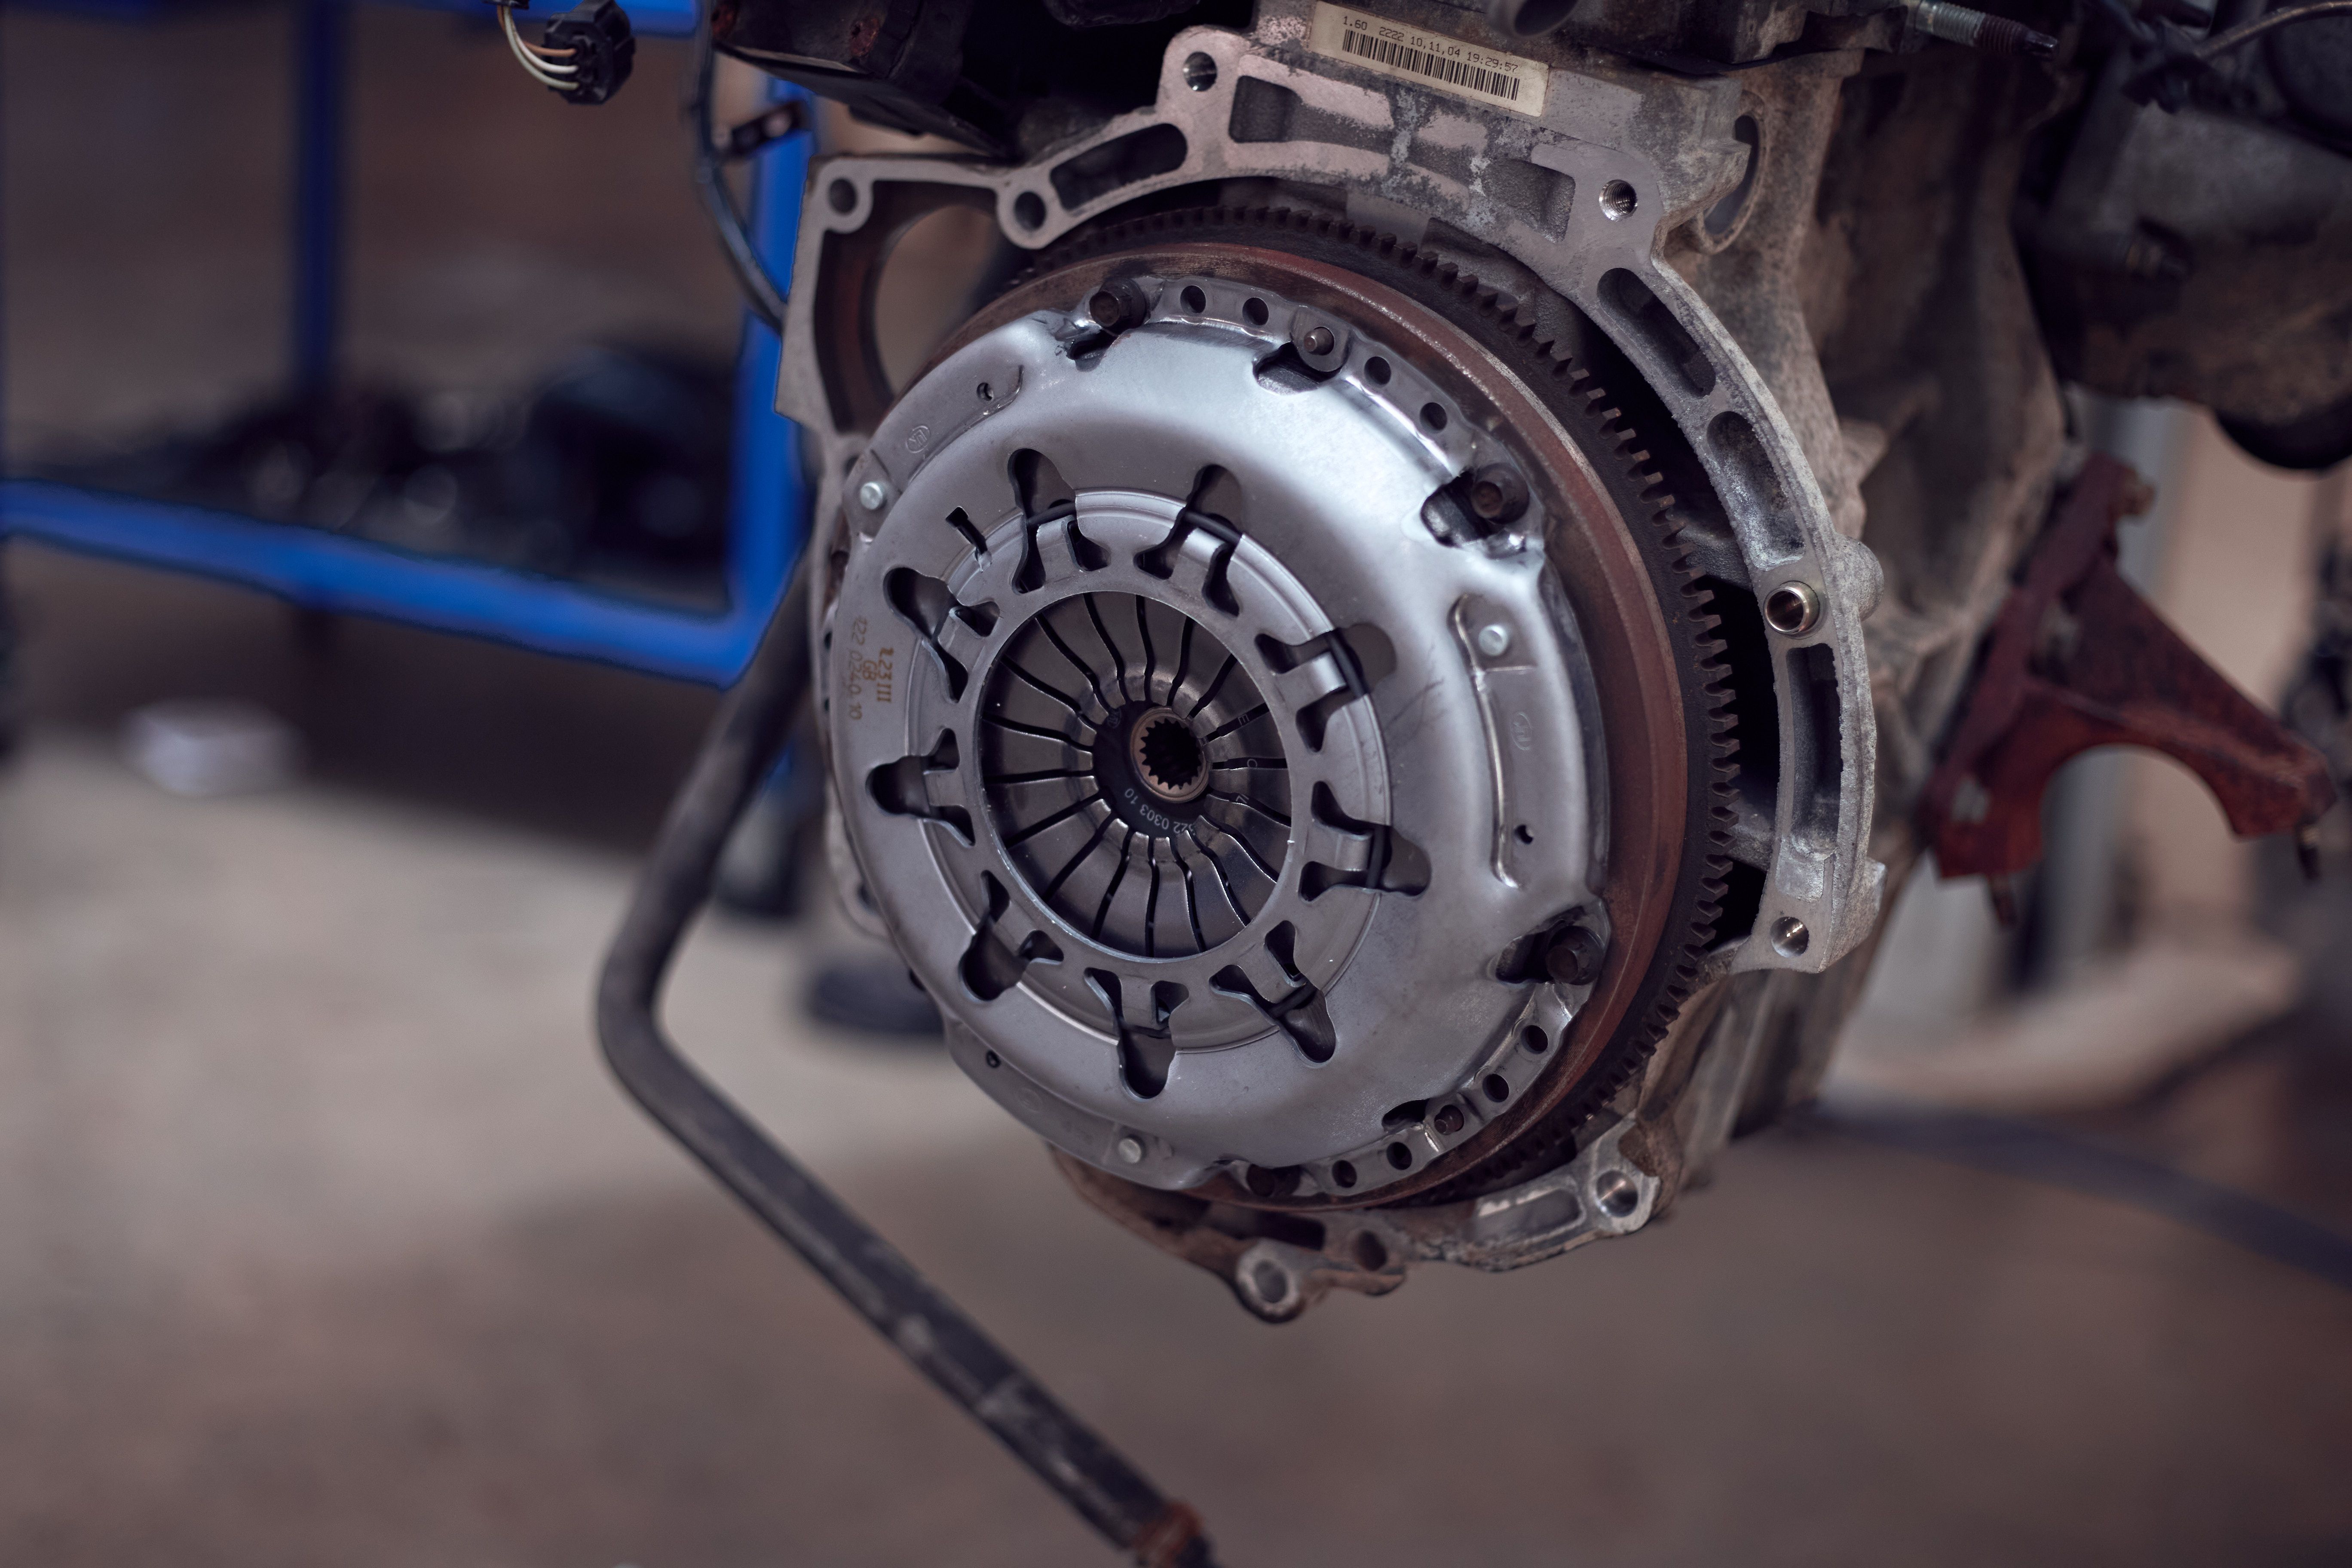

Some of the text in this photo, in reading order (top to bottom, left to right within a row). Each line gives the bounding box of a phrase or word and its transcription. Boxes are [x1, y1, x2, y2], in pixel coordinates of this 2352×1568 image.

[1344, 16, 1367, 30] 1.60
[1379, 27, 1404, 42] 2222
[1467, 52, 1518, 73] 19:29:57
[1124, 788, 1138, 804] 10
[1140, 804, 1169, 830] 0303
